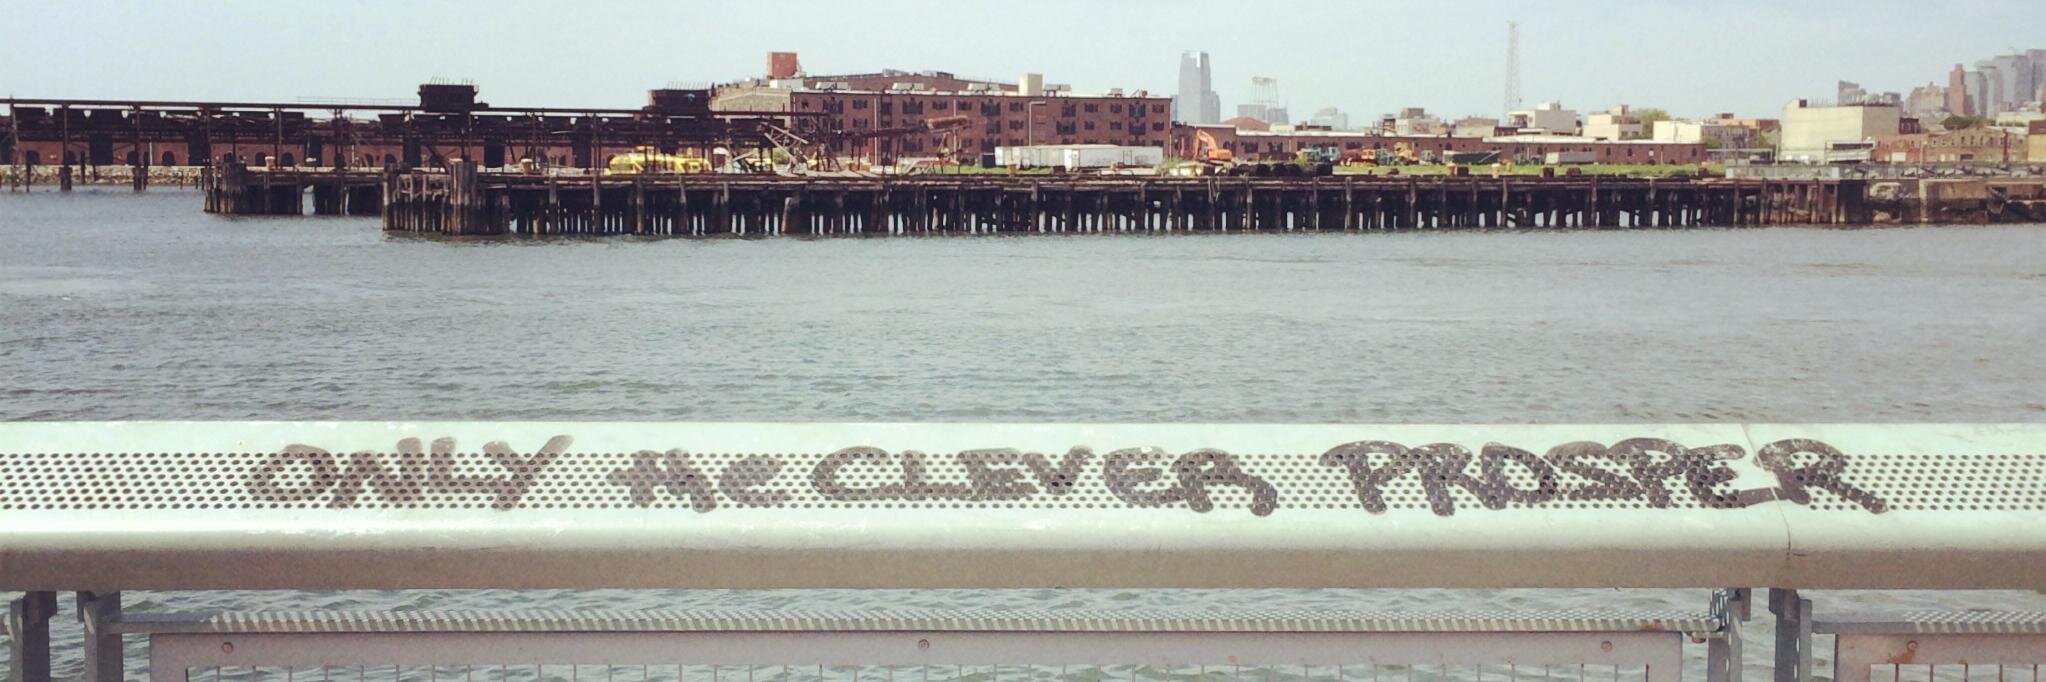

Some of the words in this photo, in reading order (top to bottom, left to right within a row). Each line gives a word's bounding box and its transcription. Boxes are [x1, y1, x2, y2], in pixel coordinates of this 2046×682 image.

[247, 435, 573, 510] ONLY
[811, 445, 1277, 516] CLEVER
[1319, 437, 1888, 516] PROSPER
